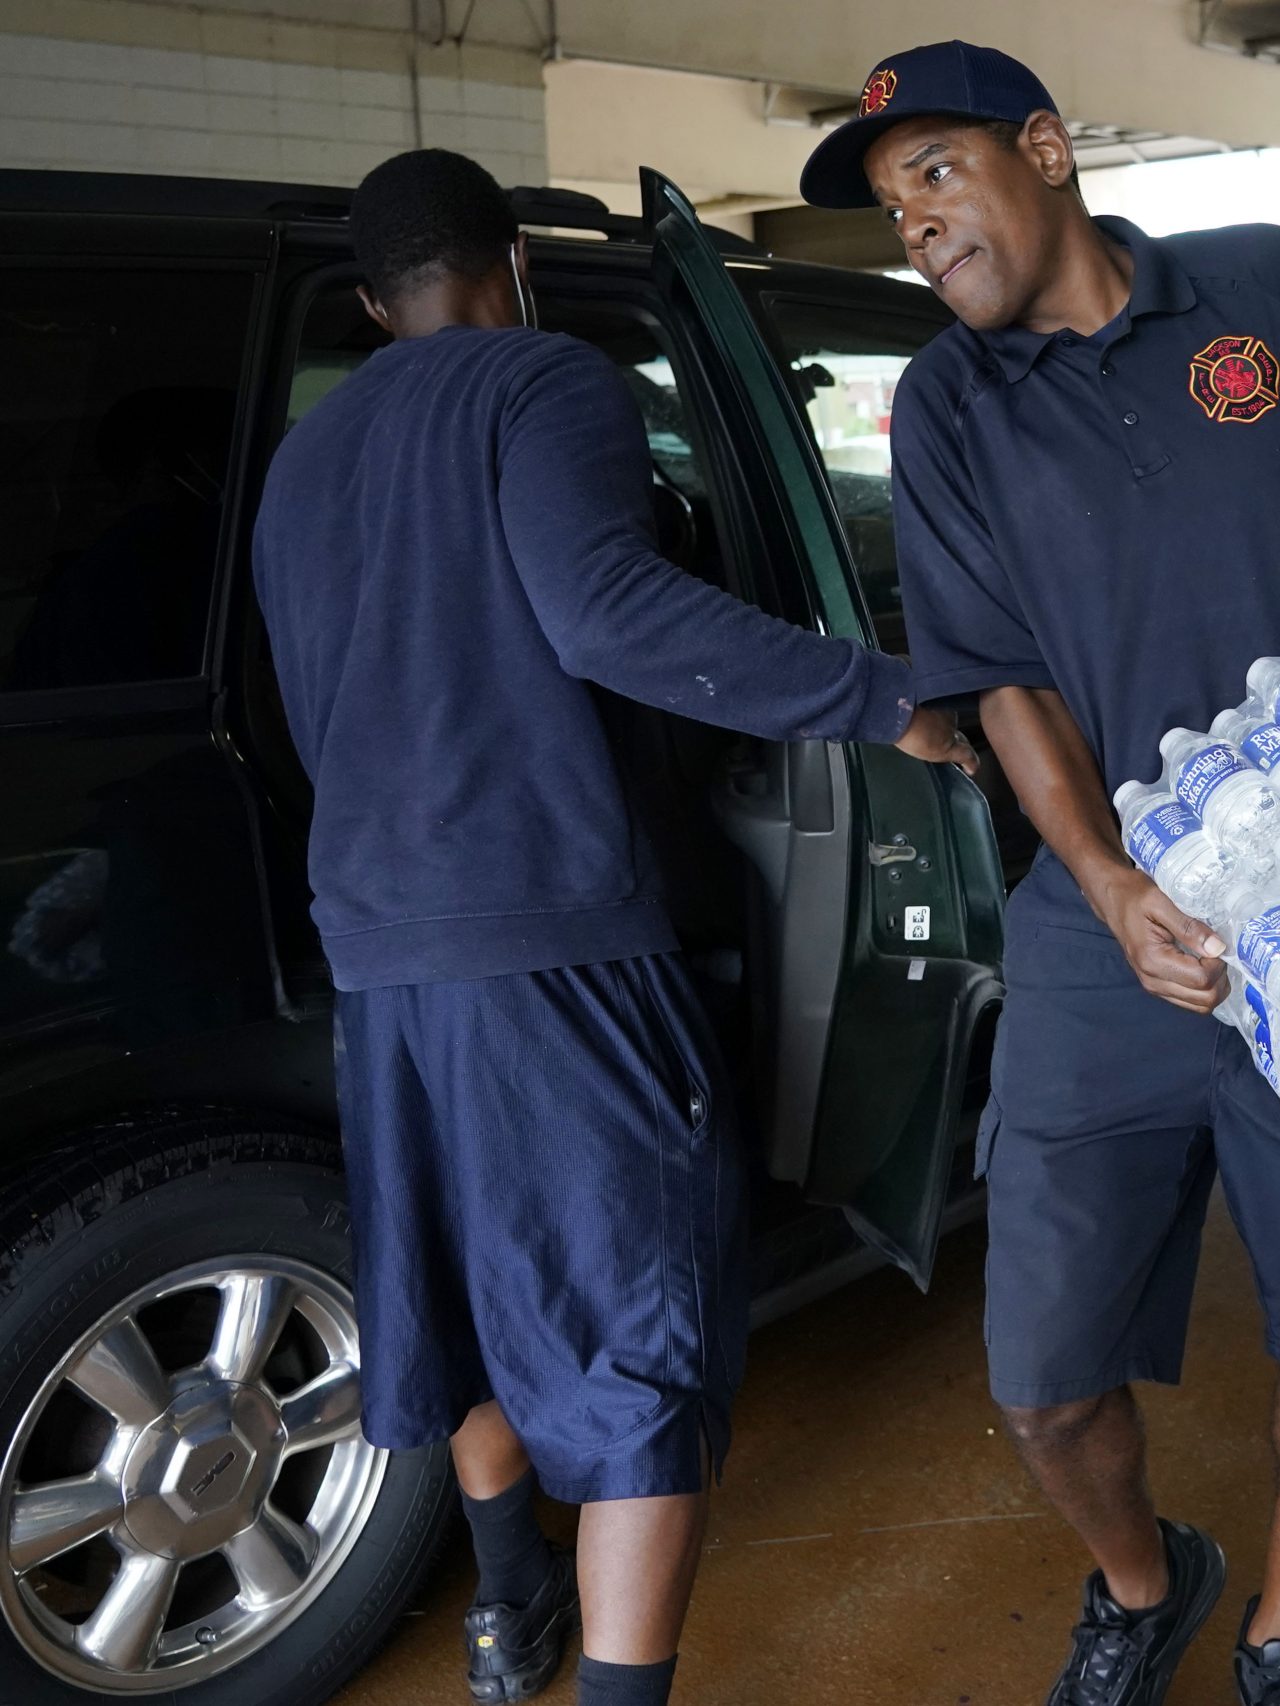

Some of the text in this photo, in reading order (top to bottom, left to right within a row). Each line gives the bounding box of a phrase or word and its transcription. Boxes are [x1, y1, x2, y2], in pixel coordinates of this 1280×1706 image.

[1199, 373, 1215, 404] FIRE
[1178, 749, 1228, 801] Running
[1187, 776, 1209, 810] Man
